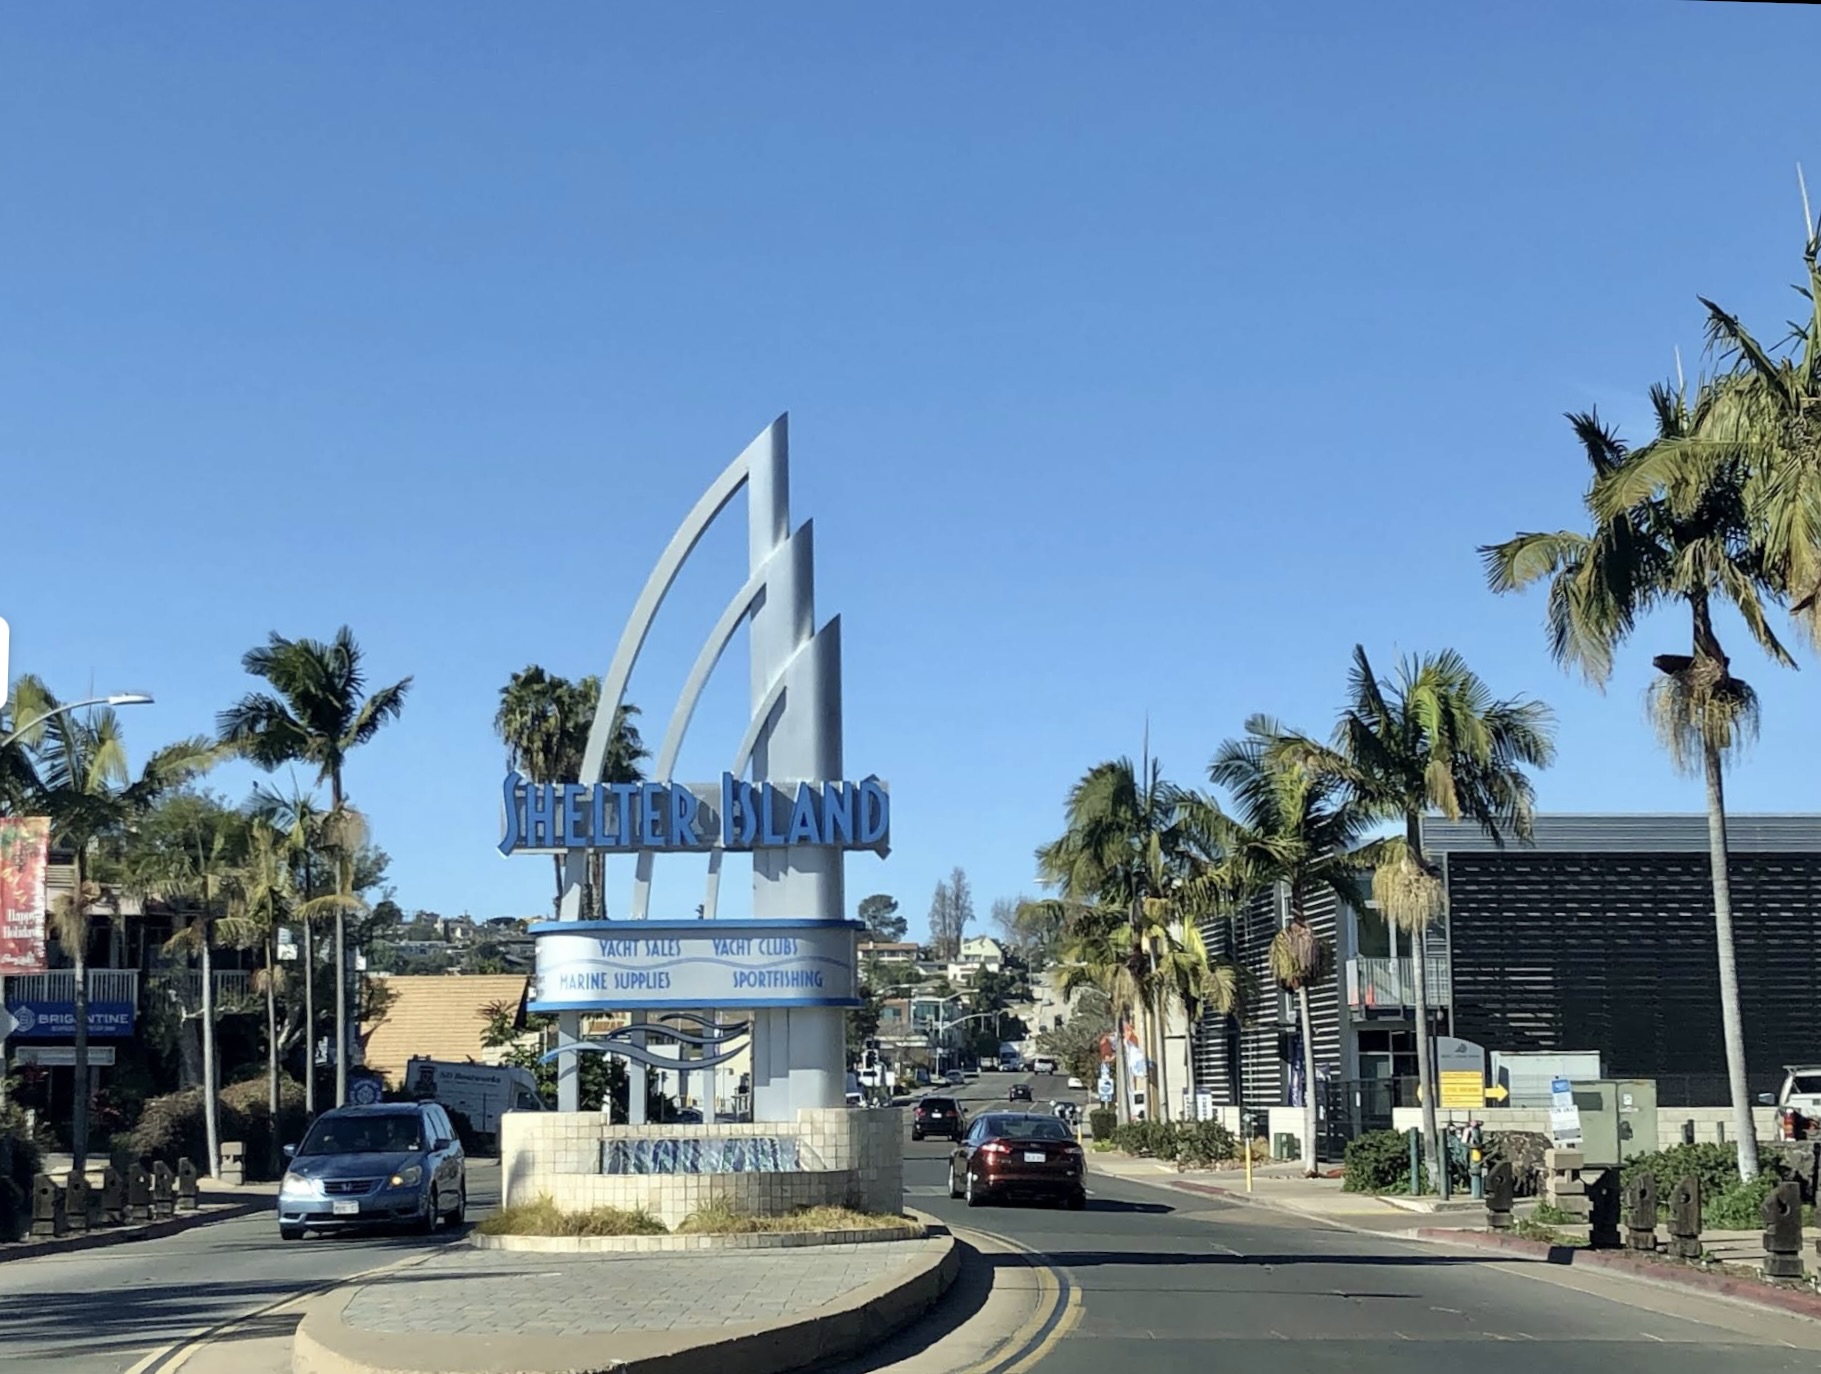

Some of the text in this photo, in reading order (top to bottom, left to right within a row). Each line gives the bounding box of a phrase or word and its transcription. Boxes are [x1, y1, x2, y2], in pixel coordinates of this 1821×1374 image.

[498, 770, 890, 859] SHELTER ISLAND
[3, 925, 39, 941] Holida
[600, 940, 681, 957] YACHT SALES
[713, 938, 798, 956] YACHT CLUBS
[560, 972, 607, 990] MARINE
[614, 971, 671, 989] SUPPLIES
[733, 970, 823, 988] SPORTFISHING
[38, 1014, 129, 1024] BRIGNTINE
